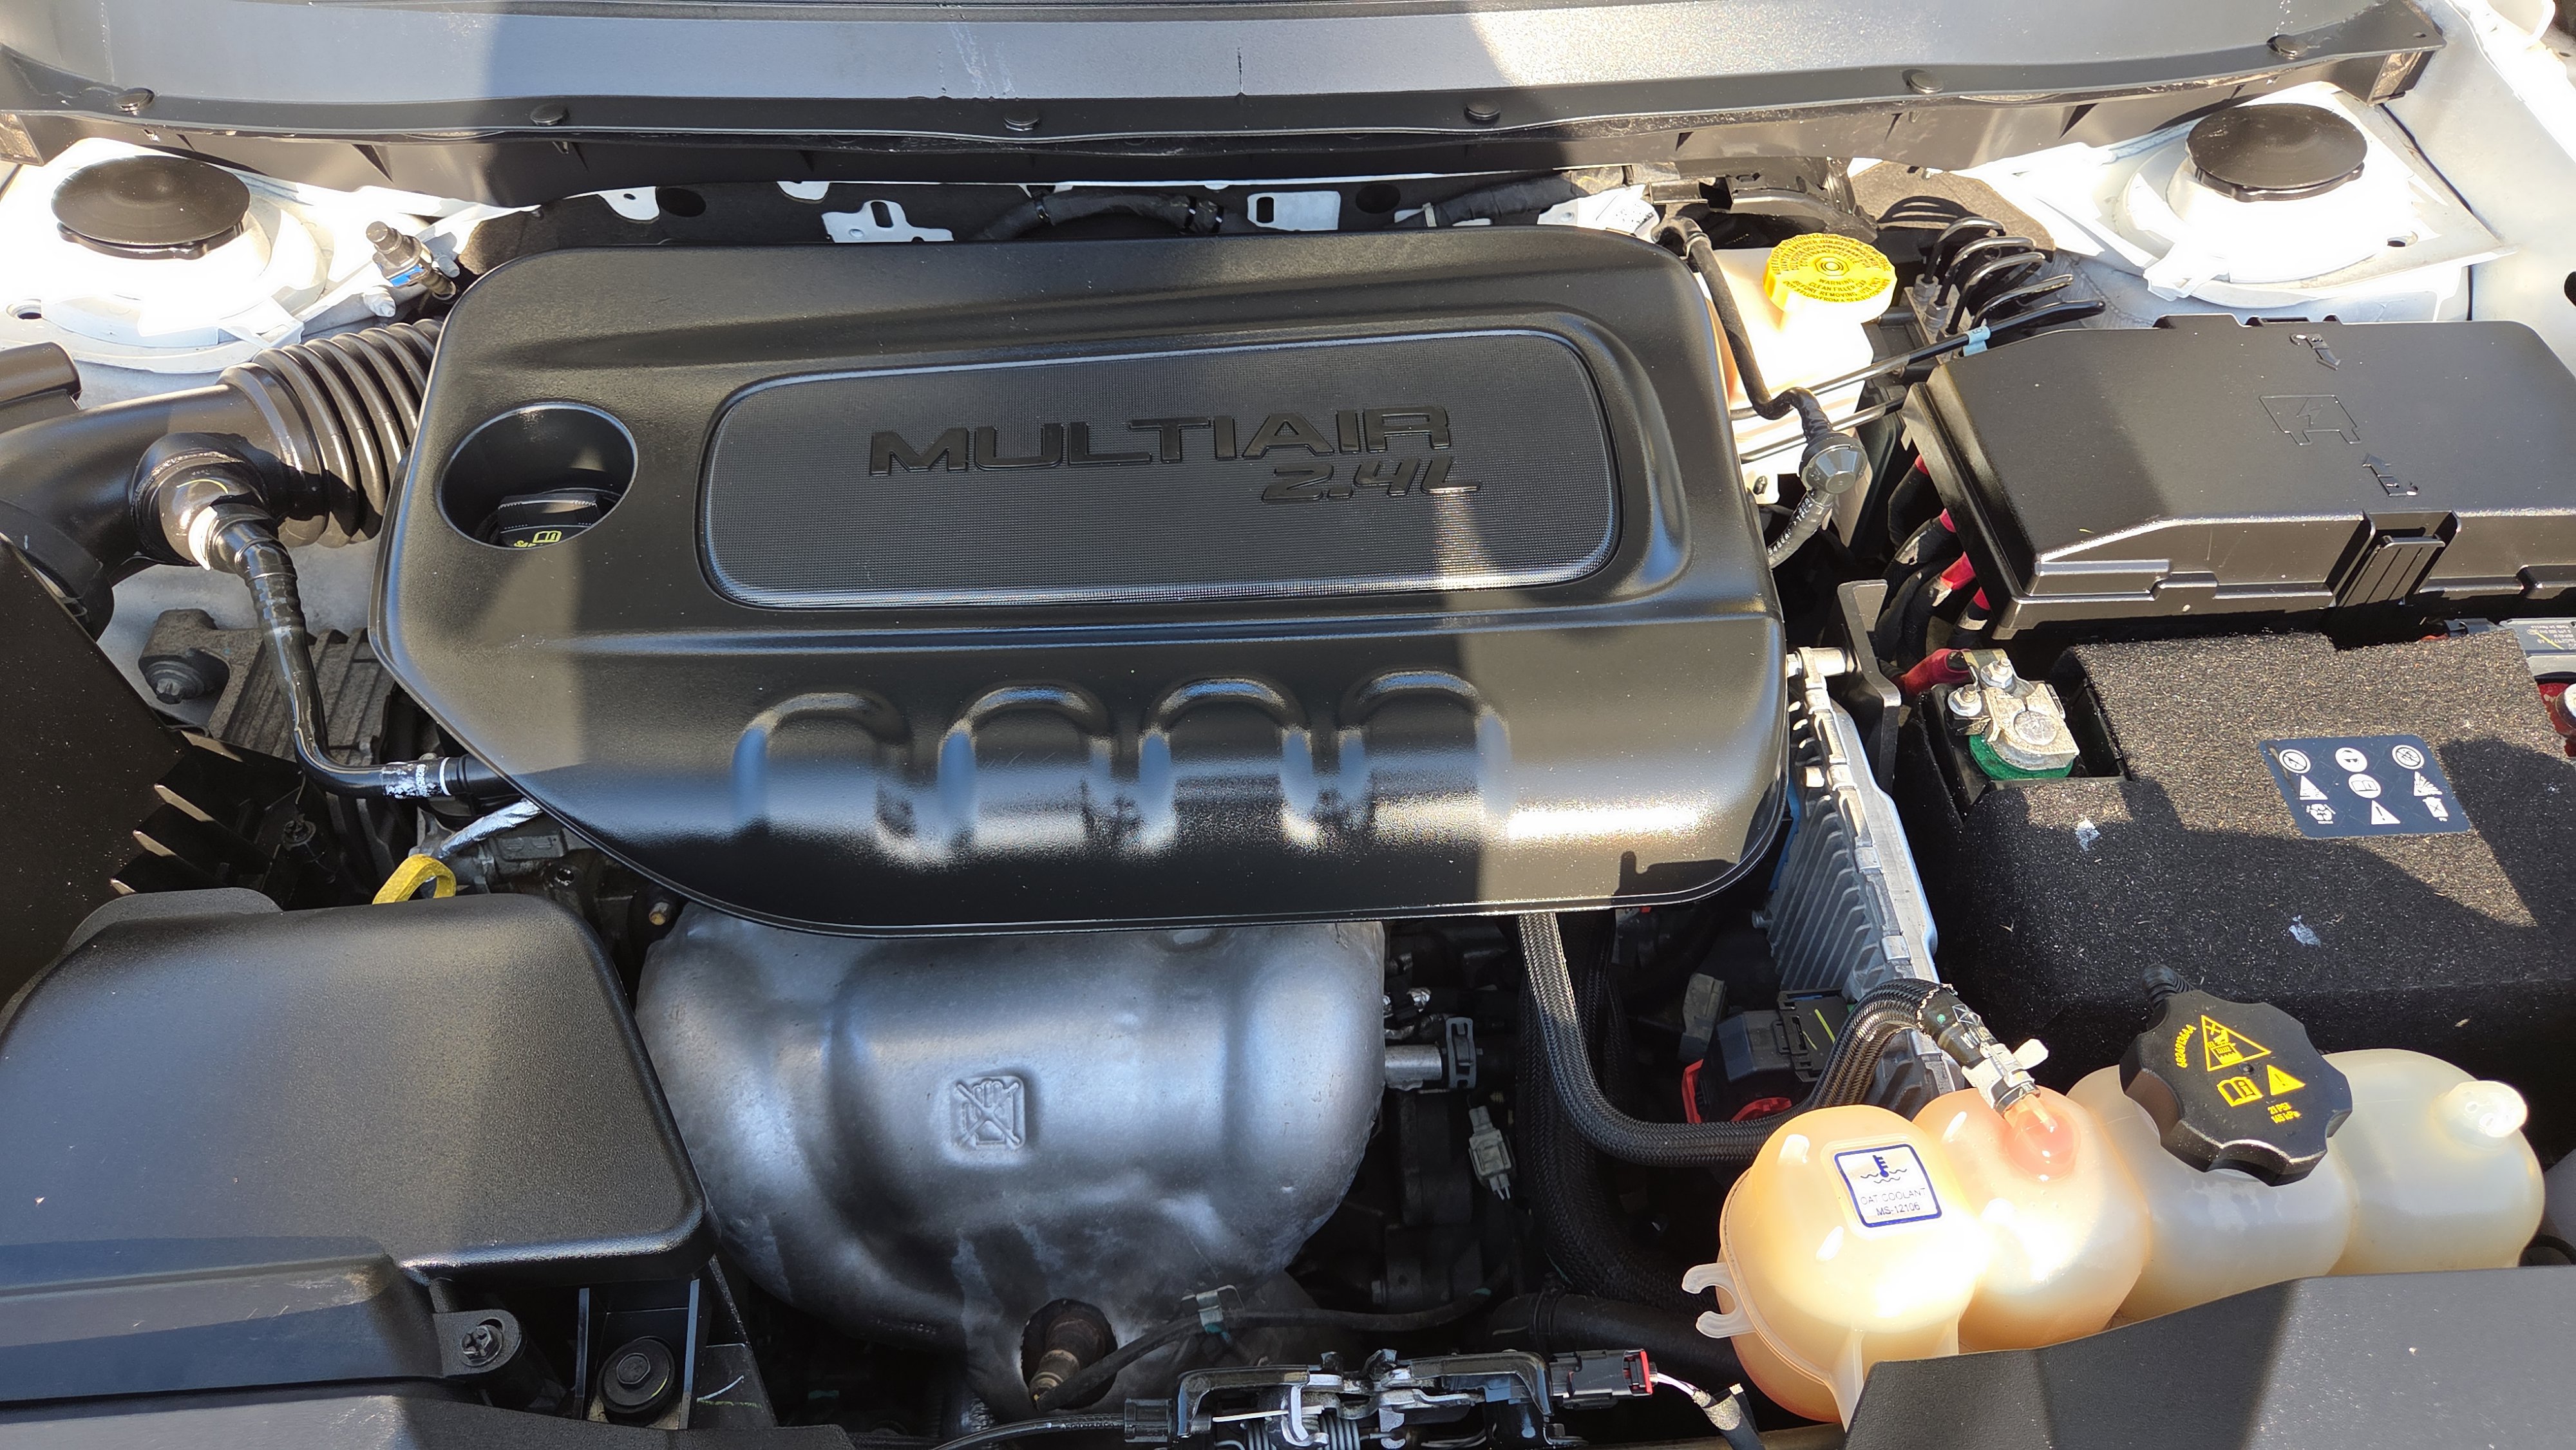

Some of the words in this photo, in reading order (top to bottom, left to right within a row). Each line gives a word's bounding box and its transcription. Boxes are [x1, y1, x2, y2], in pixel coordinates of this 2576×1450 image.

[1792, 280, 1817, 293] BEFORE
[1809, 282, 1832, 291] CLEAN
[1855, 279, 1866, 288] CAP
[1799, 290, 1819, 299] FLUID
[869, 405, 1452, 476] MULTIAIR
[1261, 457, 1481, 504] 2.4L
[2268, 1106, 2278, 1115] 21
[2275, 1102, 2292, 1113] PSI
[2271, 1113, 2286, 1124] 145
[2282, 1111, 2302, 1120] kPa
[1860, 1194, 1878, 1205] OAT
[1881, 1187, 1926, 1202] COOLANT
[1876, 1201, 1920, 1216] MS-12106
